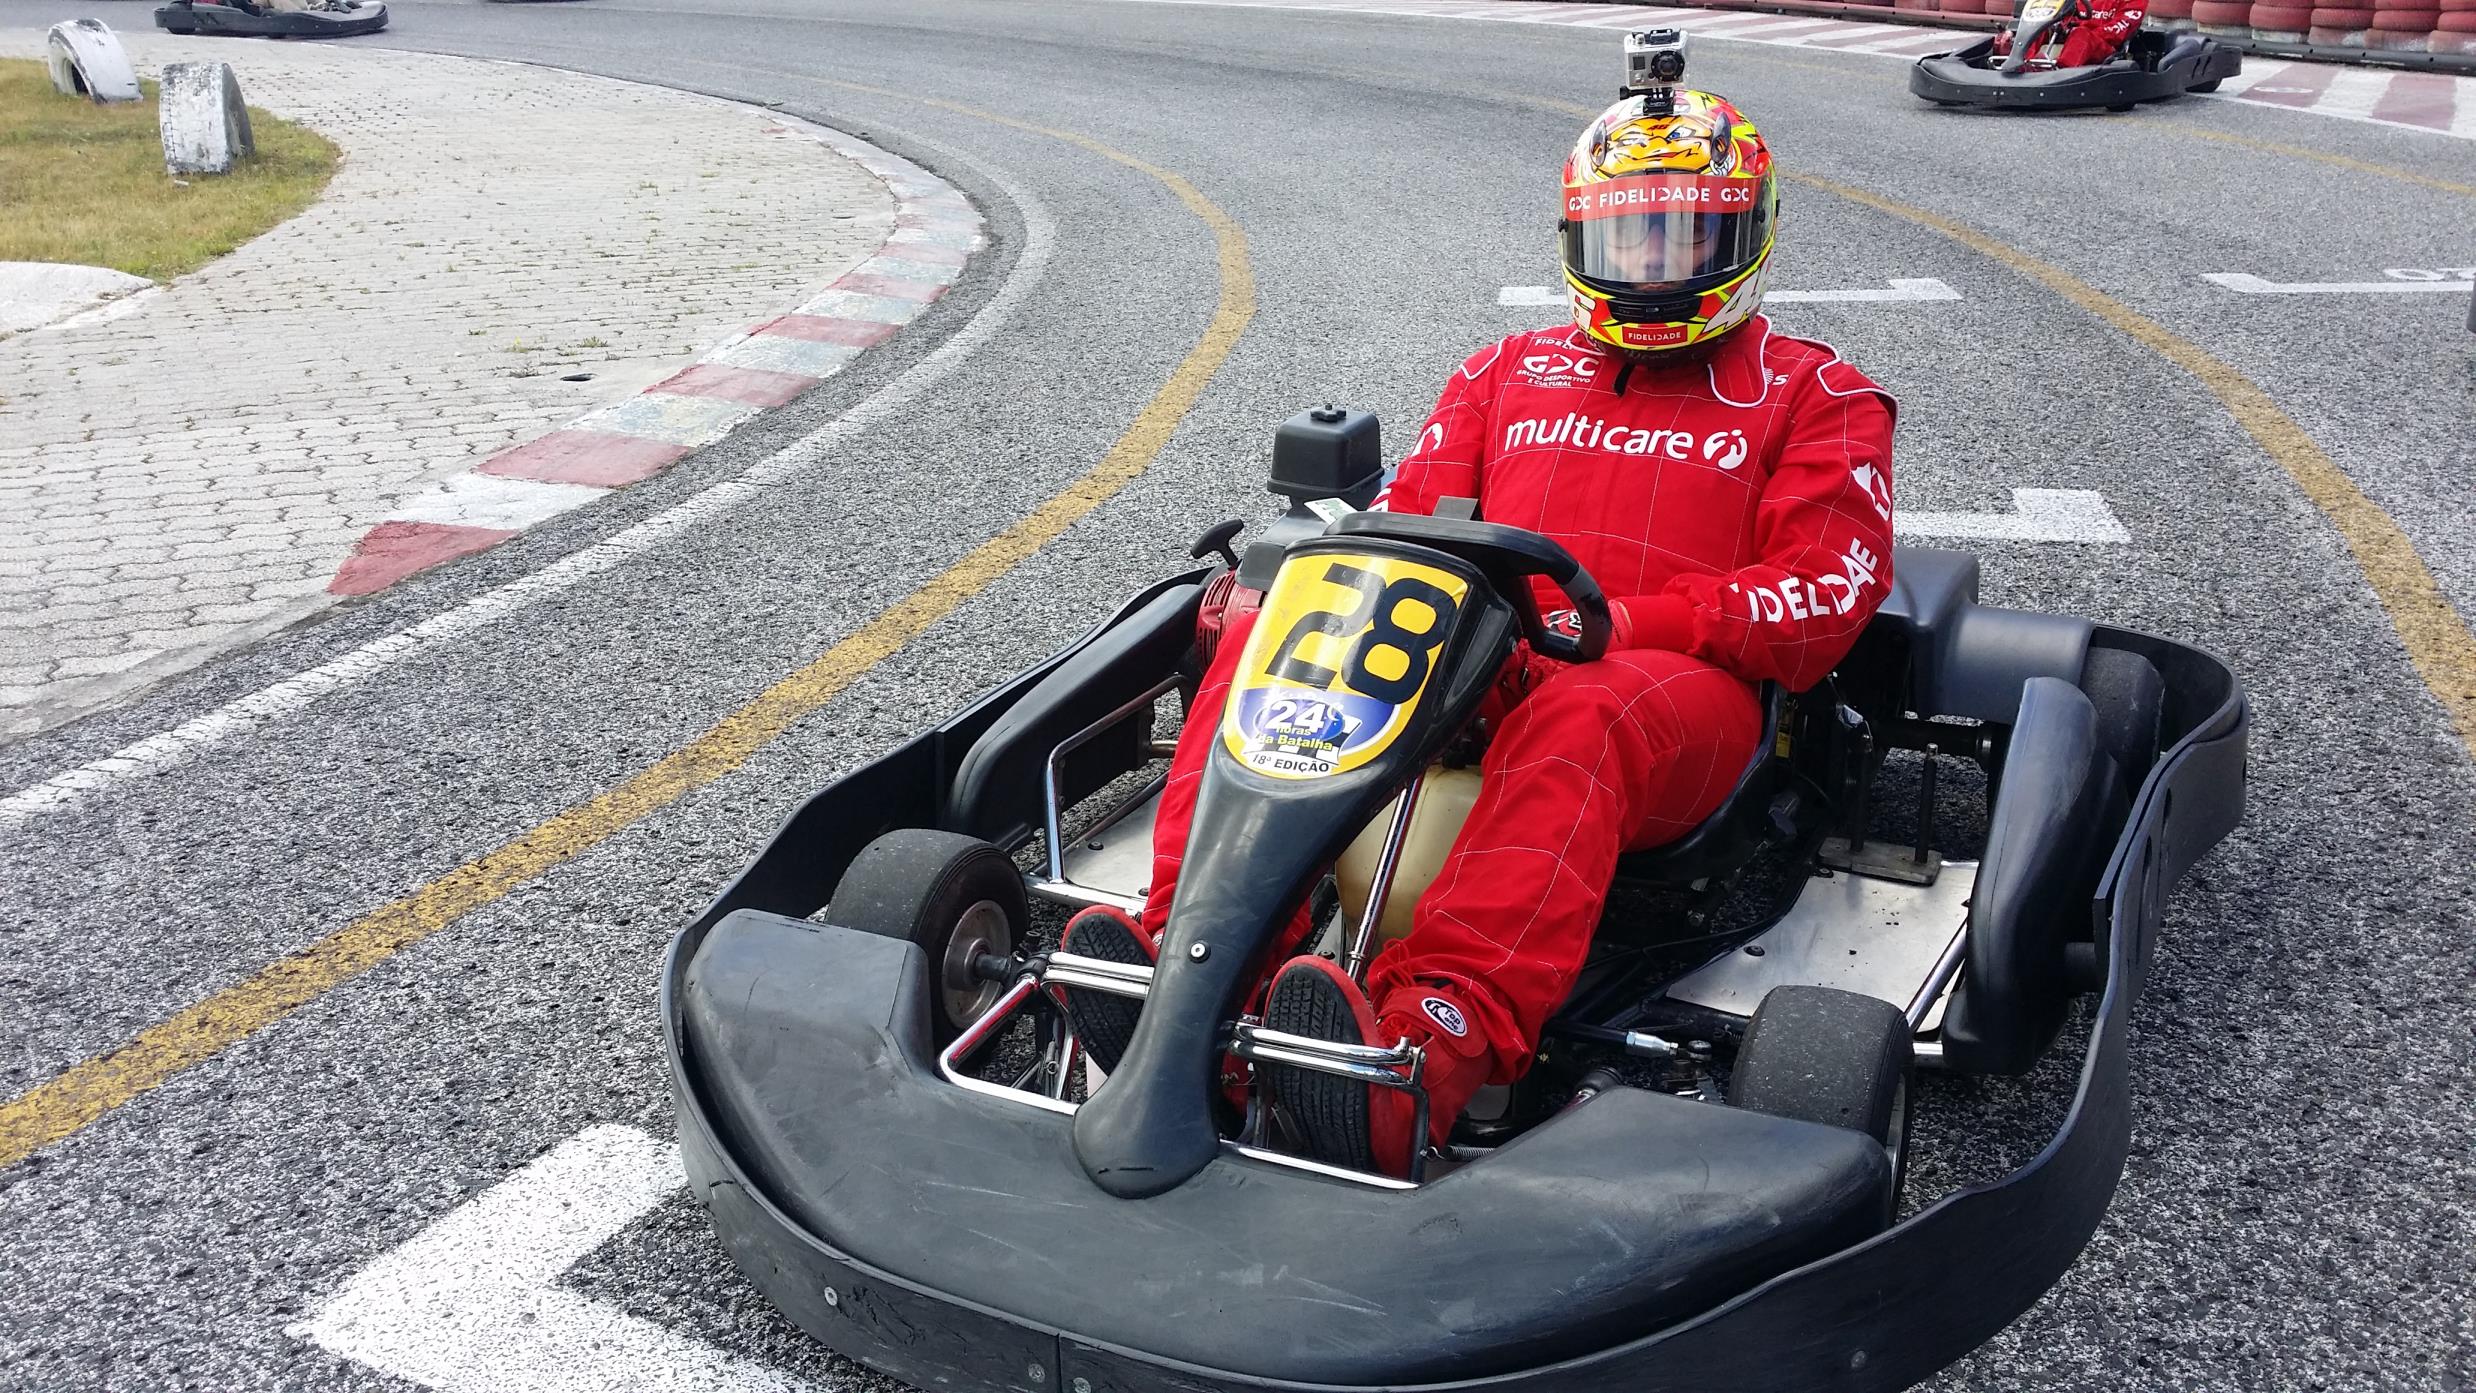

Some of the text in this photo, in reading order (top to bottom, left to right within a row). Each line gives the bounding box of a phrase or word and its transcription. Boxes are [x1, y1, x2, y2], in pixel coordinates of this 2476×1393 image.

[1599, 187, 1711, 208] FIDELIDADE
[1628, 331, 1681, 341] FIDELIDADE
[1516, 369, 1591, 383] GRUPO DESPORTIVO
[1534, 379, 1572, 387] CULTURAL
[1504, 412, 1694, 460] multicare
[1264, 562, 1458, 705] 28
[1277, 734, 1334, 751] Batalha
[1274, 758, 1330, 773] EDIÇÃO
